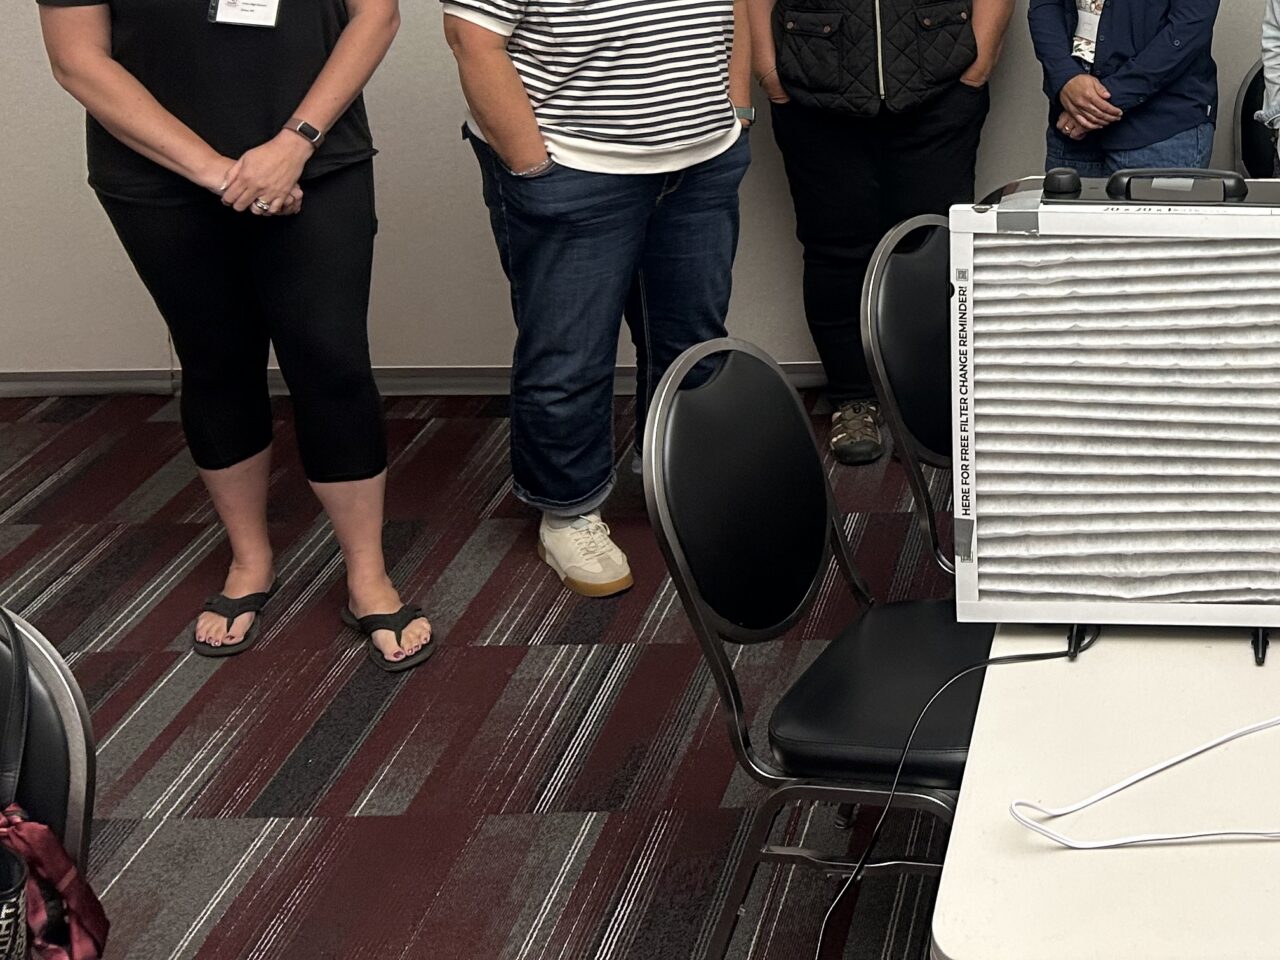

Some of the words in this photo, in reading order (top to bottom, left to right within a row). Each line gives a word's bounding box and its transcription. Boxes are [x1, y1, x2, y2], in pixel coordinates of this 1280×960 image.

[958, 286, 968, 347] REMINDER!
[959, 350, 968, 395] CHANGE
[960, 397, 969, 433] FILTER
[960, 435, 970, 461] FREE
[961, 464, 970, 485] FOR
[961, 488, 971, 516] HERE
